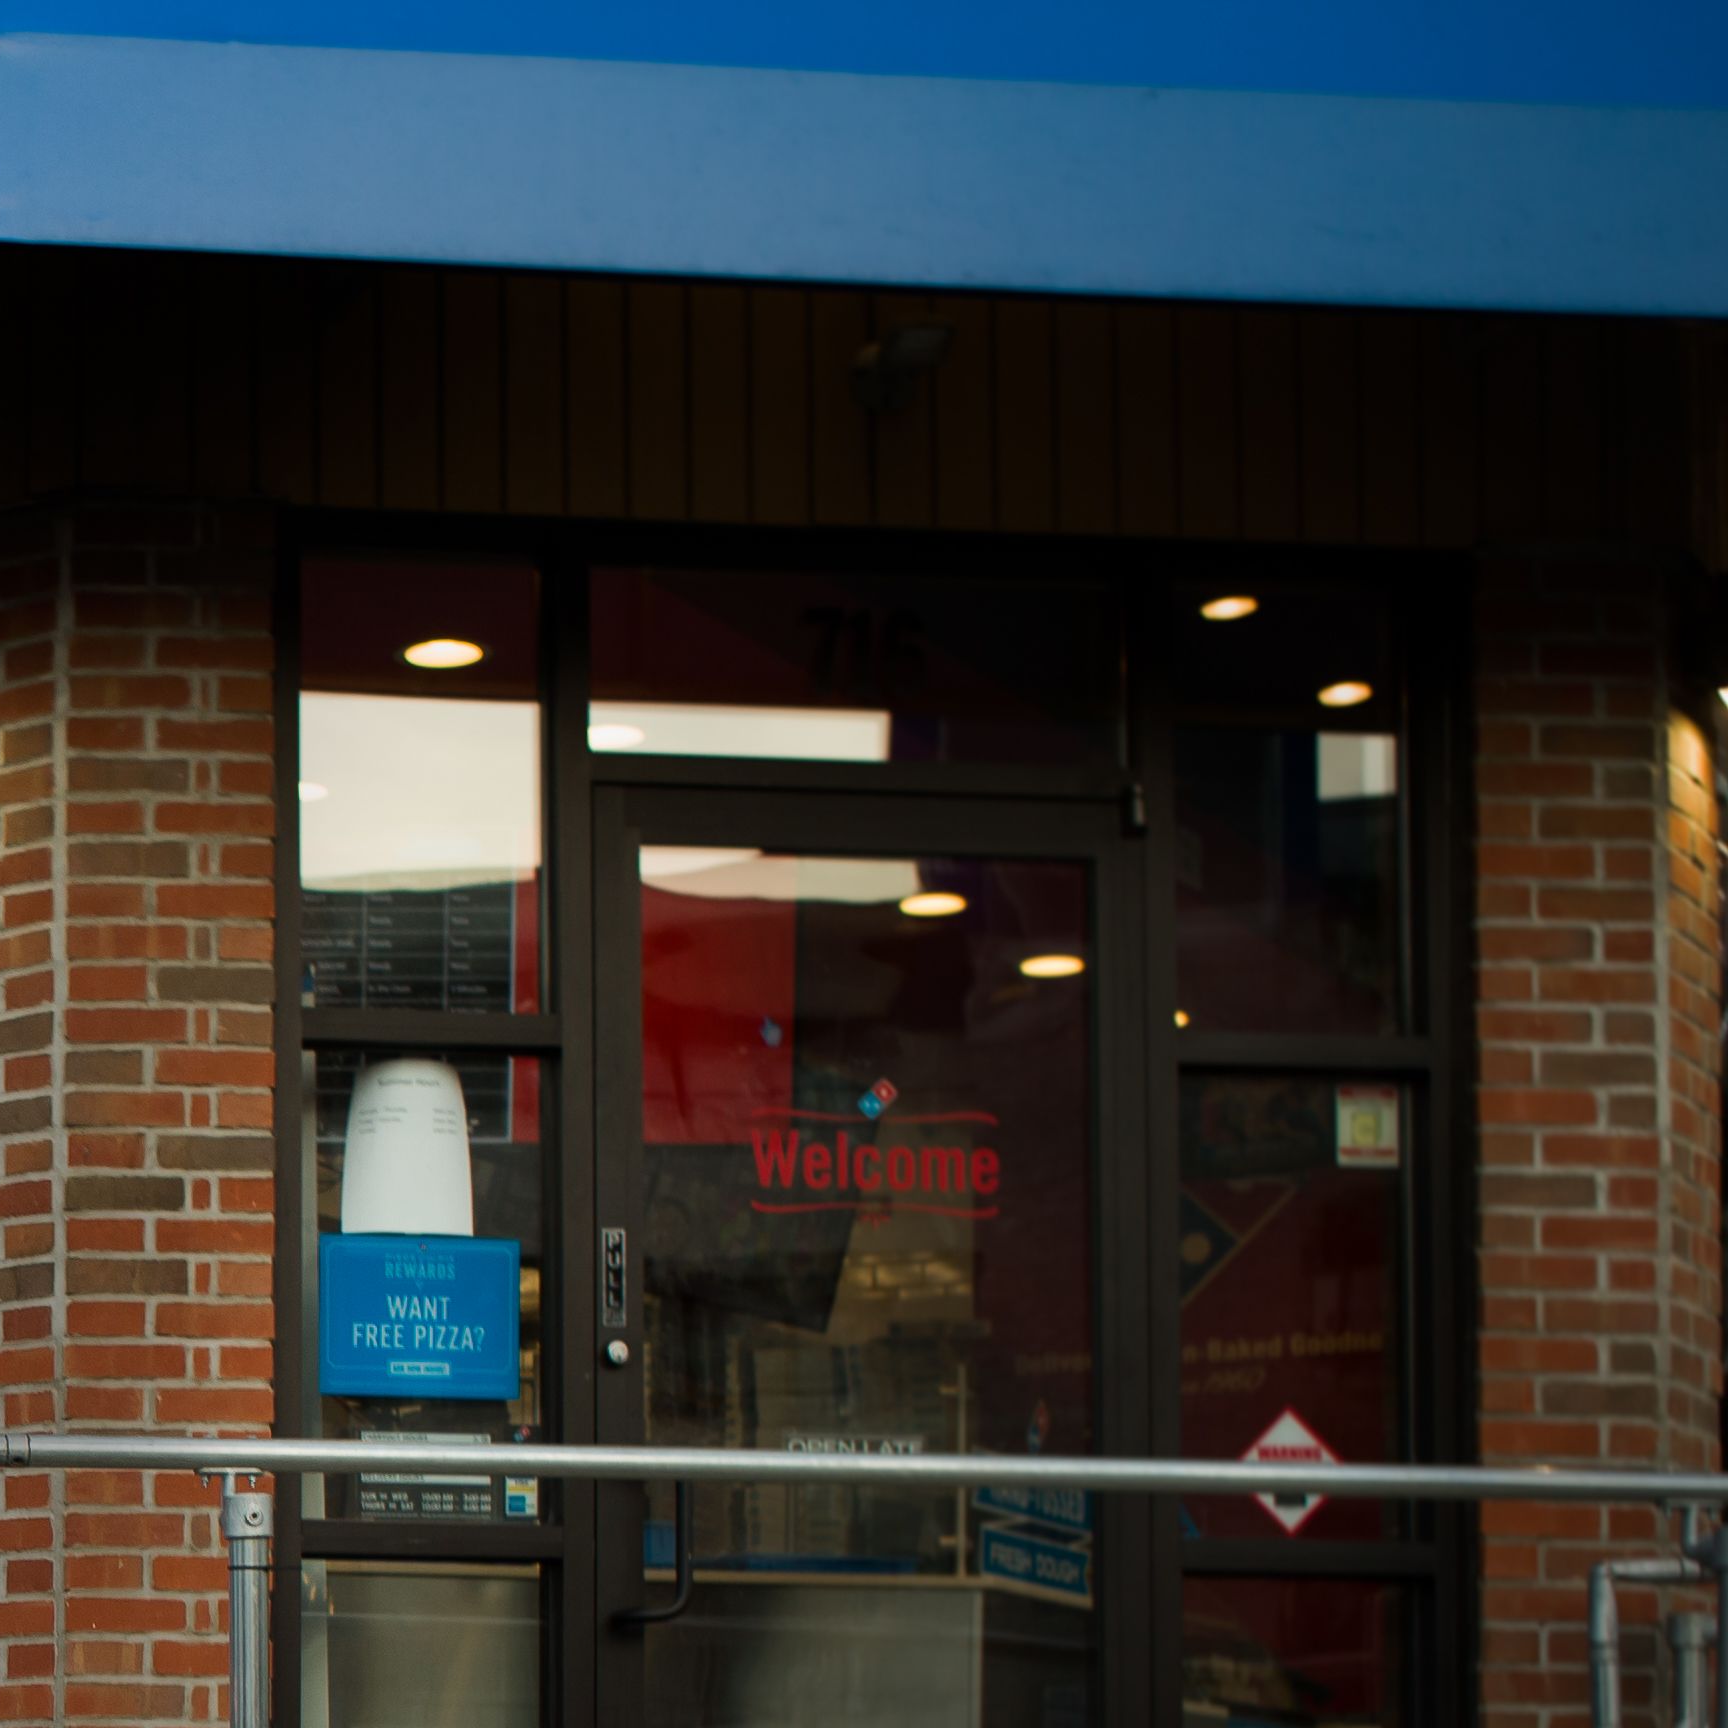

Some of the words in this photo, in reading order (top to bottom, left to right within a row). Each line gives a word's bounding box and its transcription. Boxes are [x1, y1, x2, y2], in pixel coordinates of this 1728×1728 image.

[751, 1128, 1001, 1195] Welcome
[384, 1262, 456, 1280] REWARDS
[607, 1230, 622, 1308] PULL
[386, 1294, 451, 1321] WANT
[352, 1322, 405, 1349] FREE
[414, 1325, 486, 1352] PIZZA?
